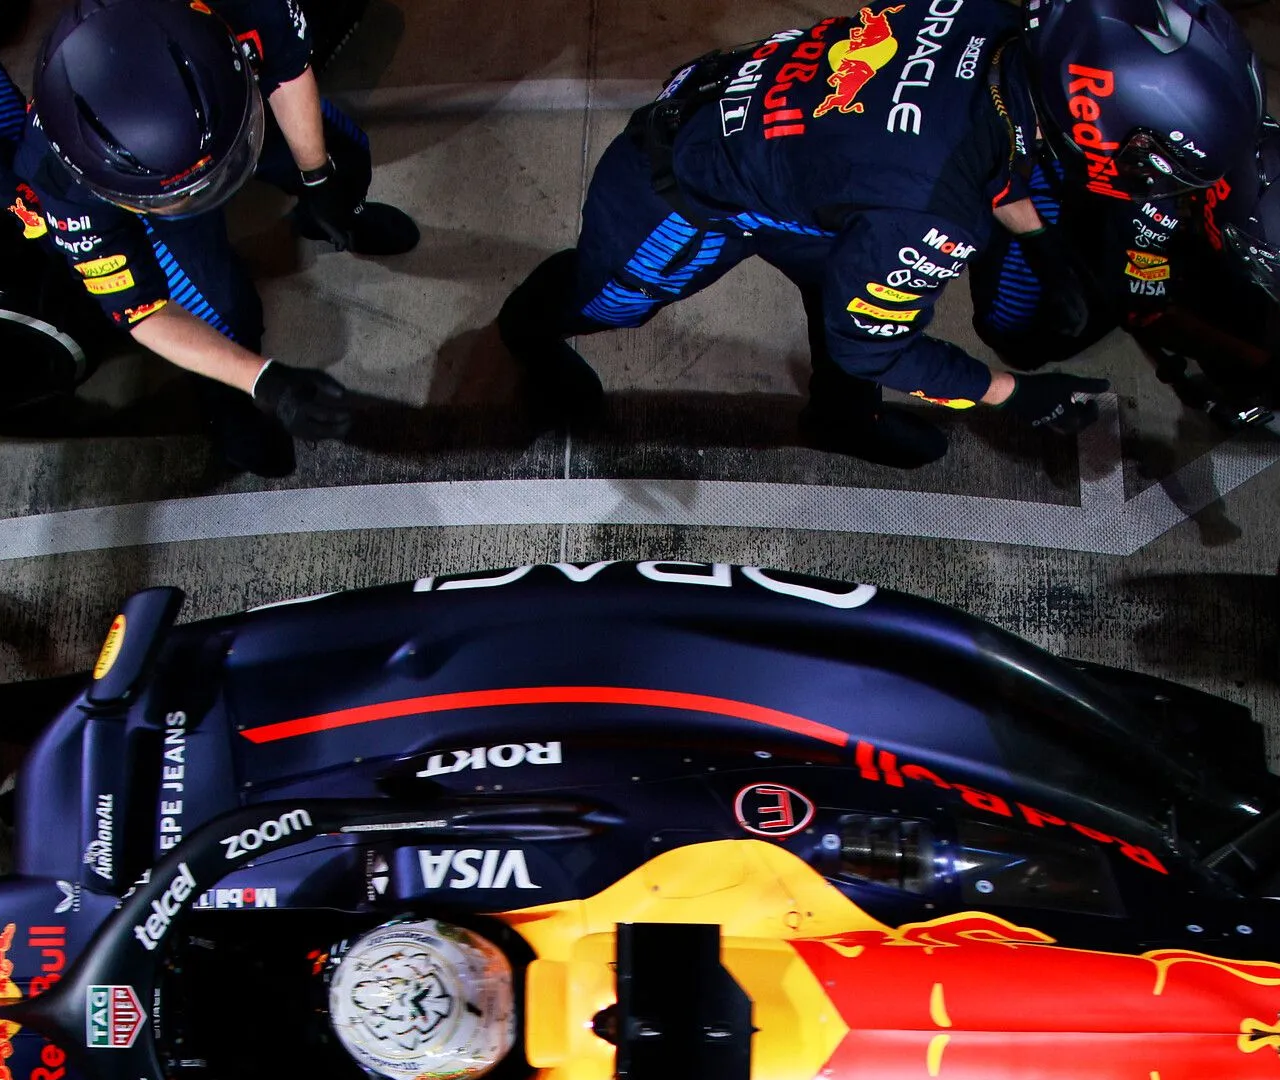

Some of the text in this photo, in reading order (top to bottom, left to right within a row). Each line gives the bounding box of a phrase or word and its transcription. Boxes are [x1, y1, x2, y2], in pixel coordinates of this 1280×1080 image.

[886, 0, 964, 136] ORACLE
[47, 211, 91, 232] Mobil
[1141, 202, 1178, 229] Mobil
[898, 247, 960, 280] Claro
[1129, 279, 1167, 297] VISA
[163, 710, 187, 793] JEANS
[416, 741, 562, 778] ROKT
[220, 808, 312, 860] zoom
[418, 849, 542, 889] VISA
[133, 862, 197, 950] telcel
[215, 888, 277, 908] Mobil
[92, 990, 108, 1042] TAG
[114, 989, 140, 1044] HEUER
